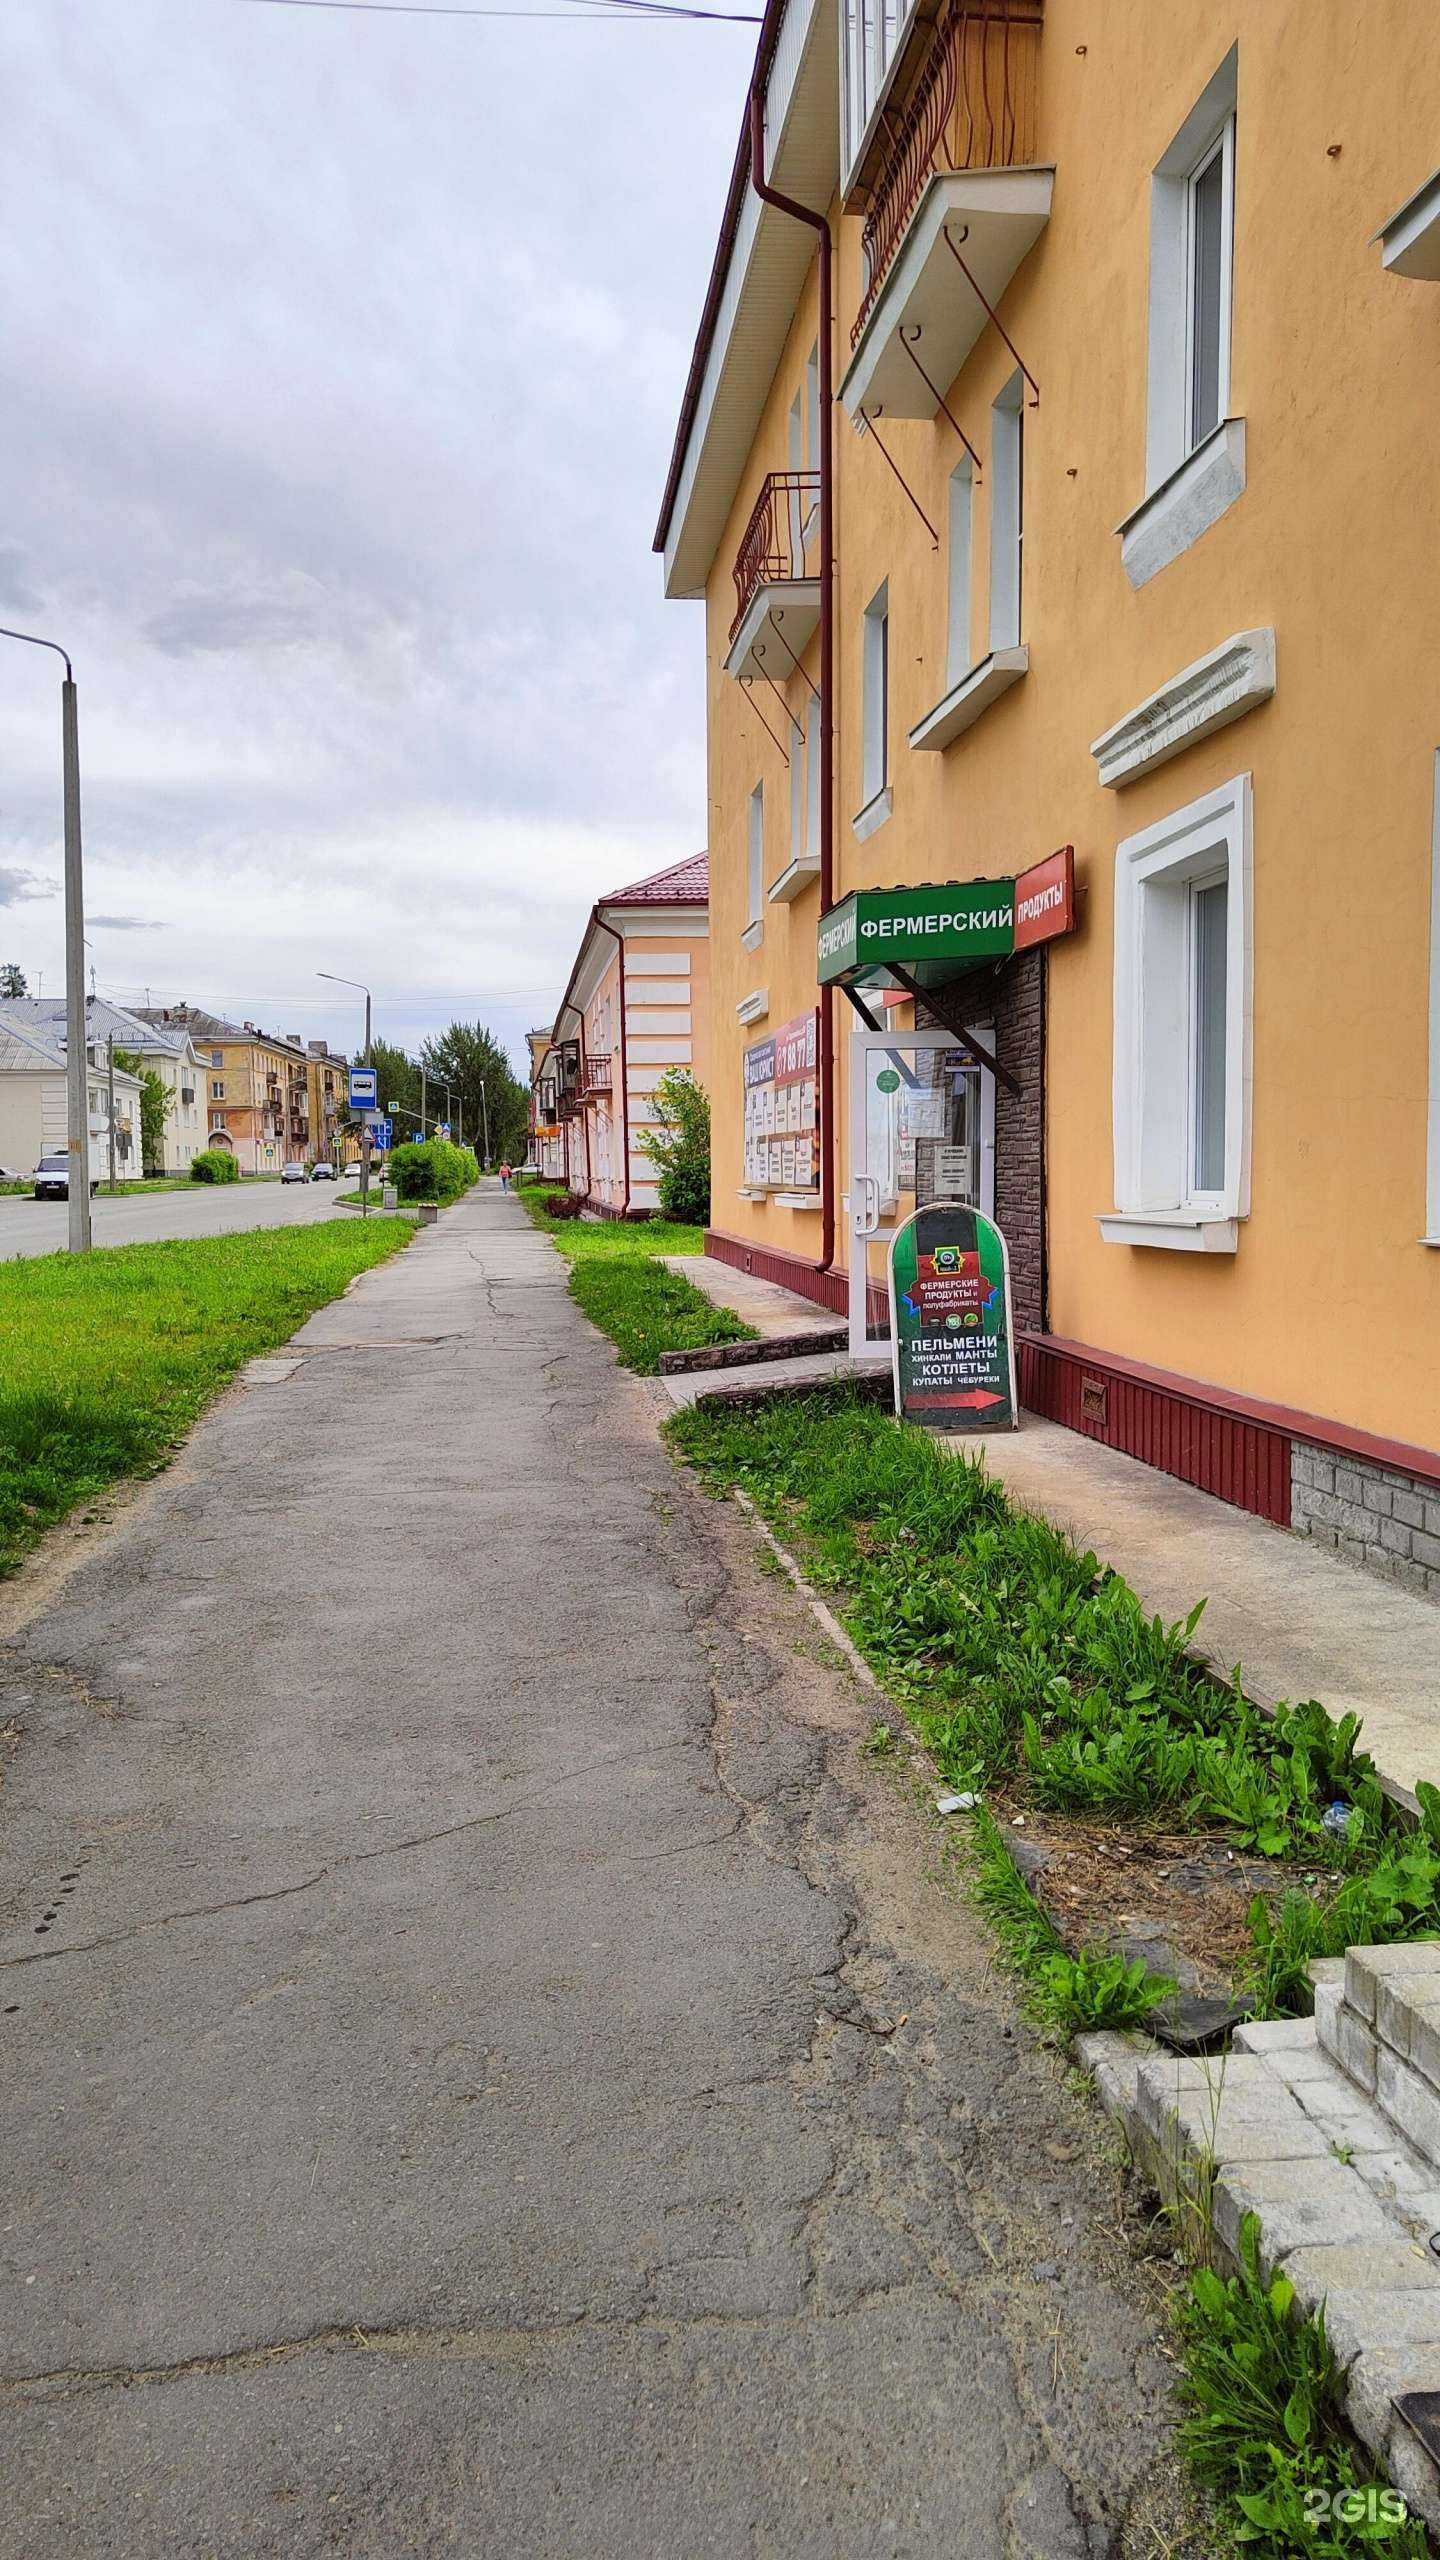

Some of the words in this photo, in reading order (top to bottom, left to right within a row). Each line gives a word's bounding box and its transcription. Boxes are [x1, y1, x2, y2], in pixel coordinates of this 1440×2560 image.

[1017, 881, 1063, 925] ПРОДУКТЫ
[860, 904, 1013, 938] ФЕРМЕРСКИЙ
[920, 1279, 979, 1290] ФЕРМЕРСКИЕ
[925, 1289, 972, 1300] ПРОДУКТЫ
[922, 1300, 979, 1311] полуфабрикаты
[911, 1335, 998, 1352] ПЕЛЬМЕНИ
[911, 1353, 952, 1363] ХИНКАЛИ
[955, 1349, 998, 1361] МАНТЫ
[922, 1361, 990, 1376] КОТЛЕТЫ
[912, 1376, 953, 1387] КУПАТЫ
[957, 1375, 1000, 1385] ЧЕБУРЕКИ
